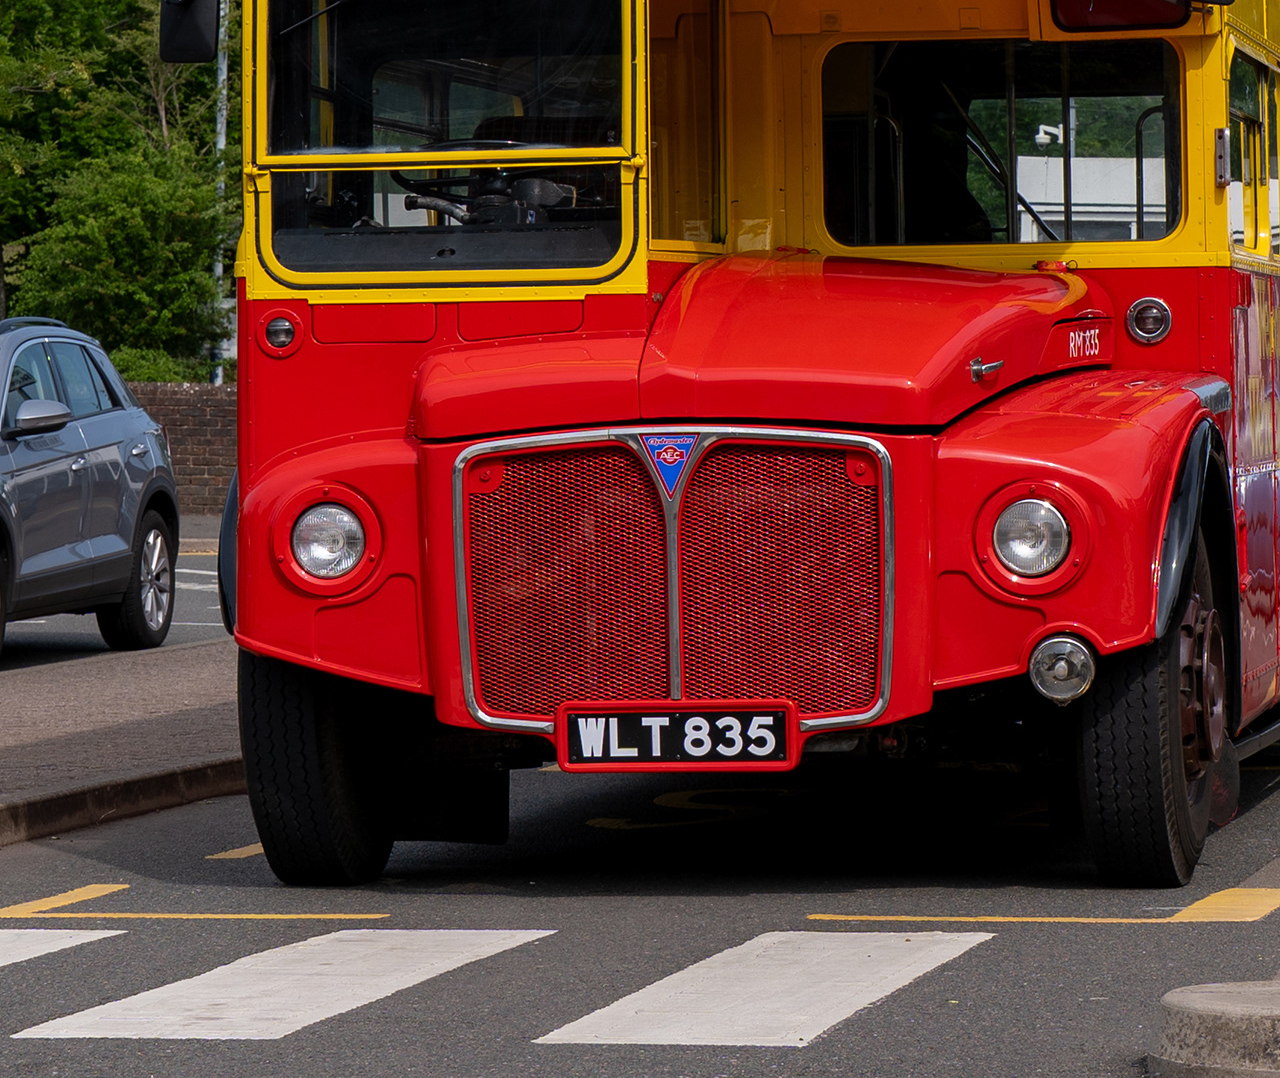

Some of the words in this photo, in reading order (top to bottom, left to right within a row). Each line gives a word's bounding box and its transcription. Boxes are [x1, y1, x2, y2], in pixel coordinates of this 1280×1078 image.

[1069, 331, 1084, 358] RM
[1085, 329, 1100, 357] 835
[660, 451, 681, 459] AEC
[577, 716, 670, 758] WLT
[683, 716, 776, 757] 835
